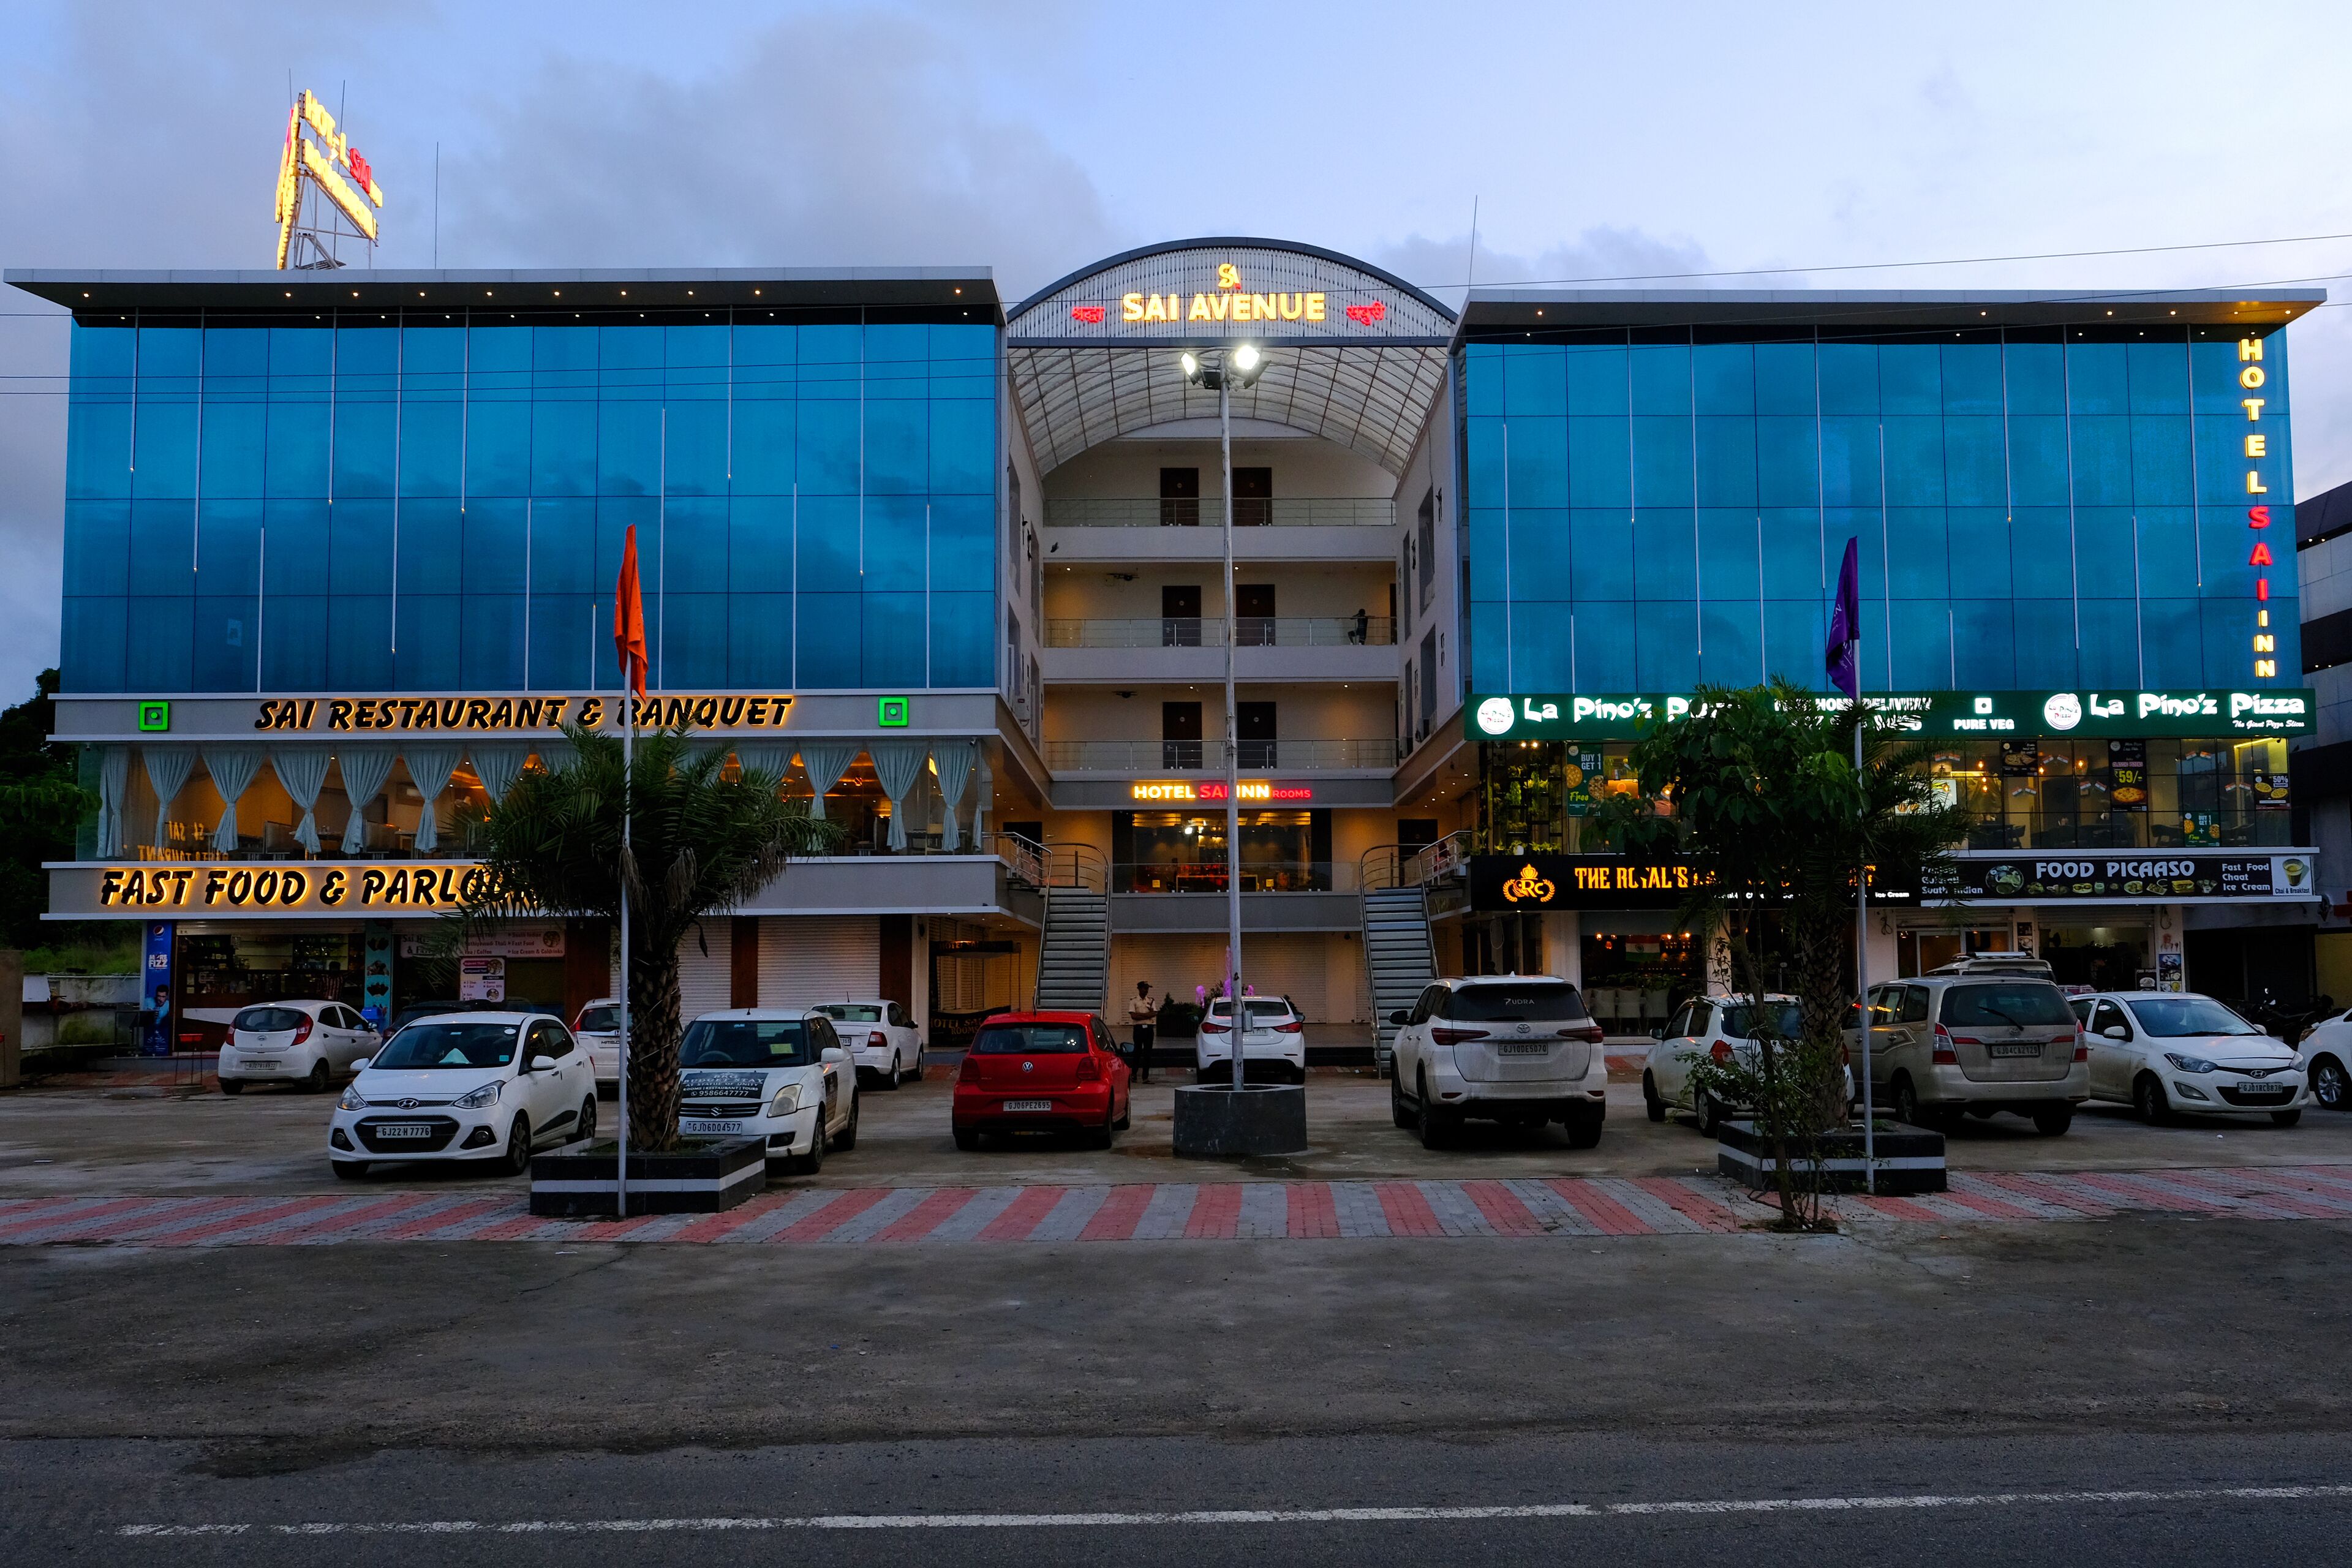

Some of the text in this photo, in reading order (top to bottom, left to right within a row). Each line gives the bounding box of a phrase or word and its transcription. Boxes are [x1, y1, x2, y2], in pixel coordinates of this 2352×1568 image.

[1123, 293, 1325, 322] SAI AVENUE
[2239, 338, 2275, 677] HOTEL SAI INN
[255, 698, 793, 731] SAI RESTAURANT & BANQUET
[1524, 698, 1559, 722] La
[1574, 697, 1652, 723] Pino'z
[2089, 693, 2305, 719] La Pino'z Pizza
[1954, 718, 2015, 729] PURE VEG
[1597, 753, 1601, 762] 1
[1134, 785, 1311, 799] HOTEL SAI INN ROOMS
[1570, 791, 1589, 802] Free
[1575, 867, 1610, 889] THE
[2037, 861, 2195, 879] FOOD PICAASO
[101, 870, 195, 905] FAST
[205, 870, 308, 905] FOOD
[320, 870, 347, 905] &
[1504, 1044, 1547, 1054] GJ10DE5070
